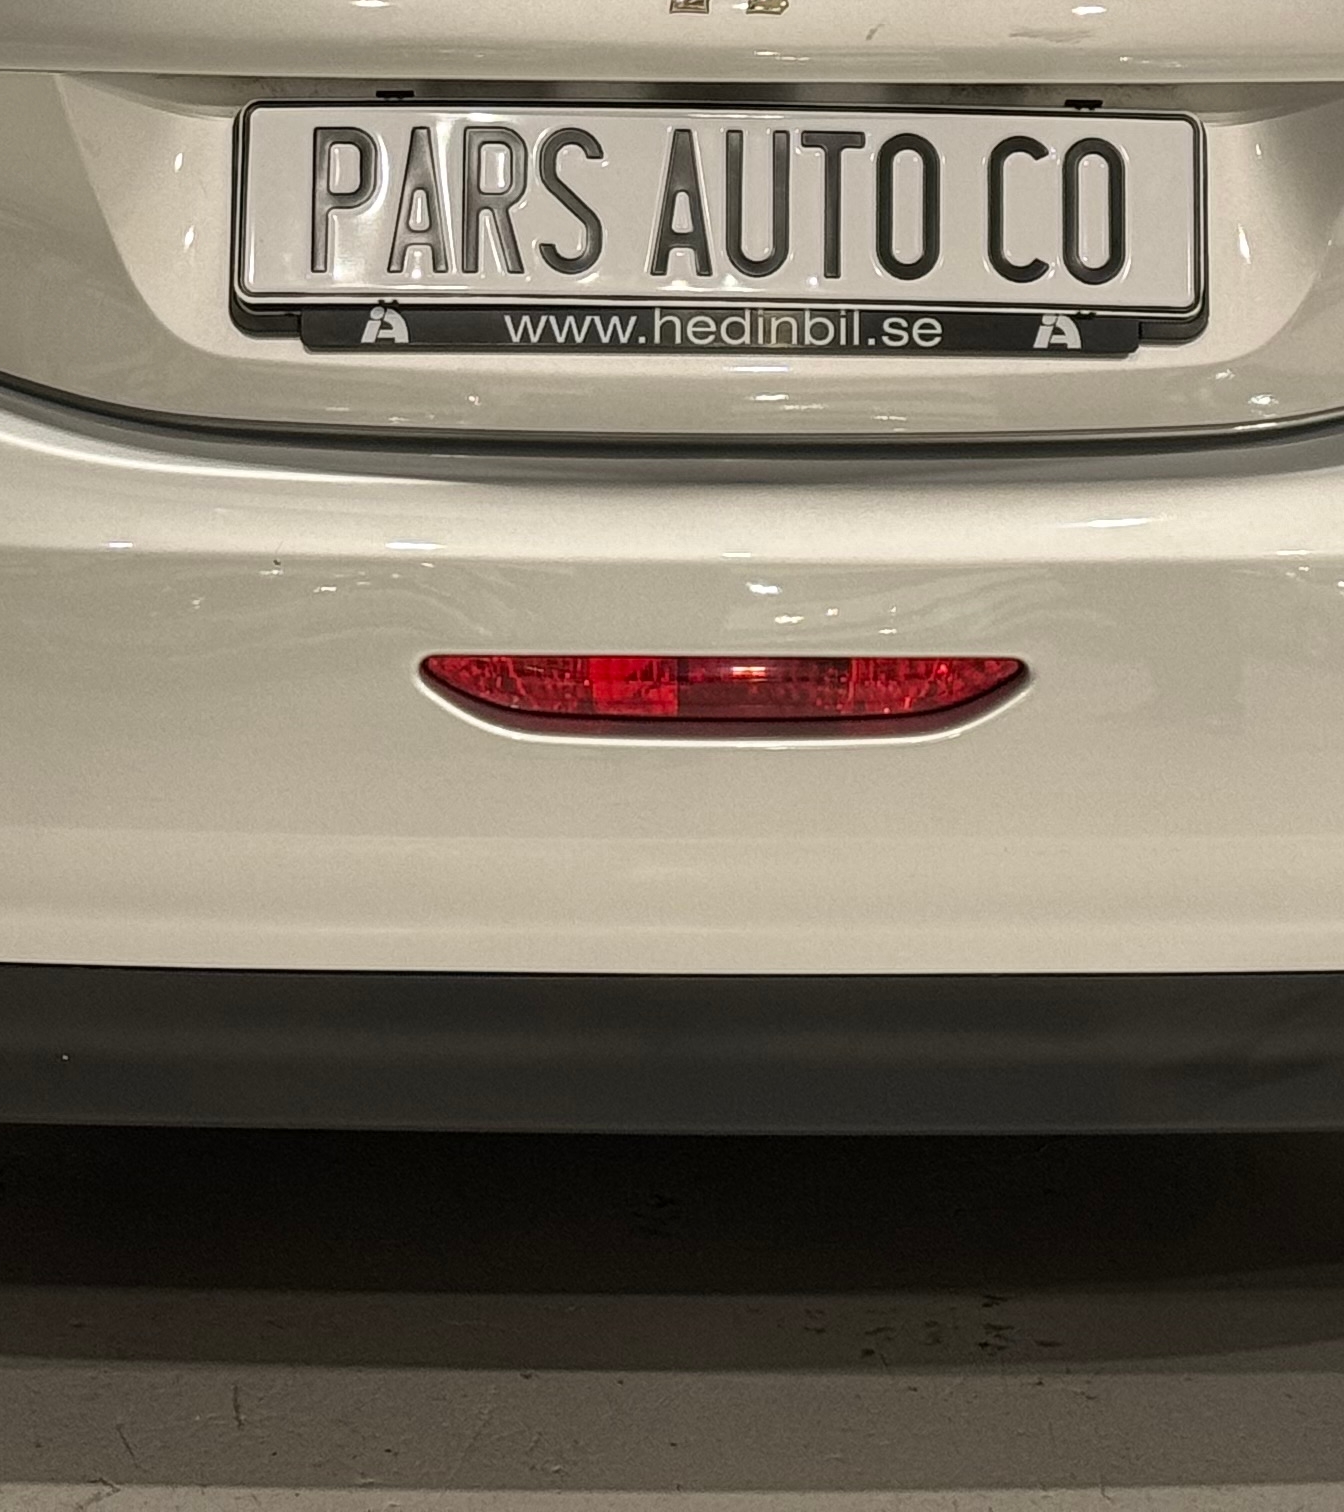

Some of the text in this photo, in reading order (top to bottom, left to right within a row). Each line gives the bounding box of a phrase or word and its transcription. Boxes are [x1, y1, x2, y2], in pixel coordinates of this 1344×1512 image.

[311, 126, 1126, 285] PARS AUTO CO
[503, 307, 943, 348] www.hedinbil.se
